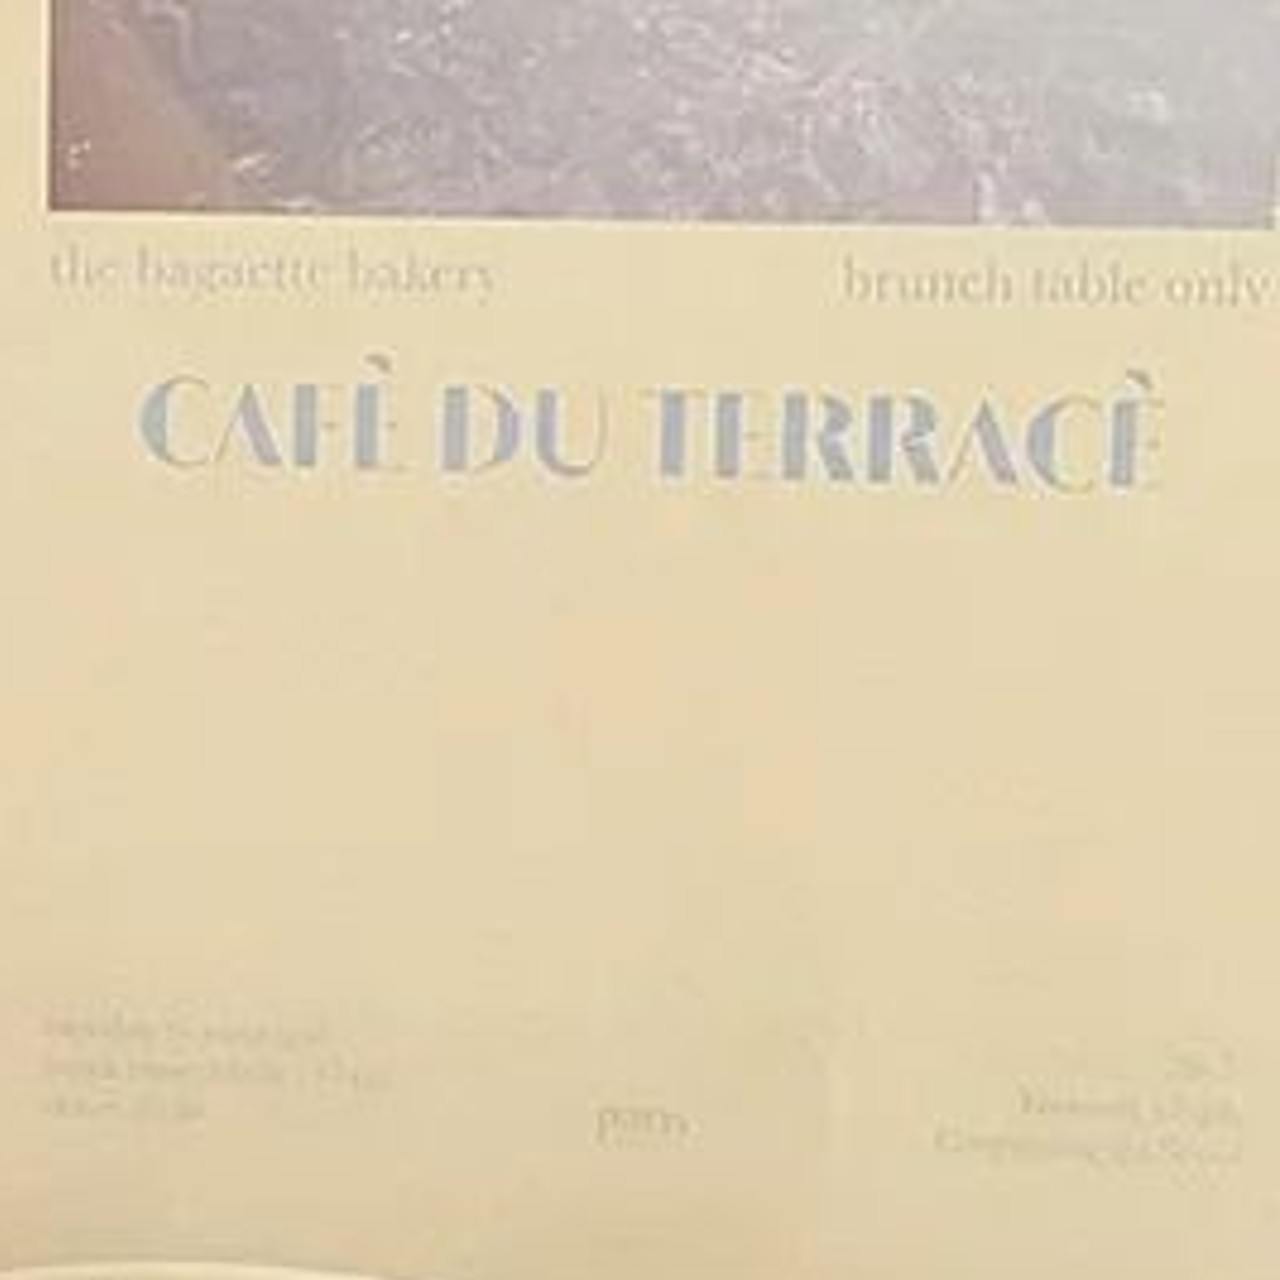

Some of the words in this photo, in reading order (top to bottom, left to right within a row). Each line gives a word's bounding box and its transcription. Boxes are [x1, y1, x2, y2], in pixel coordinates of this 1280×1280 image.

[50, 243, 118, 288] the
[842, 254, 1014, 303] brunch
[1032, 260, 1149, 306] table
[440, 385, 610, 477] DU
